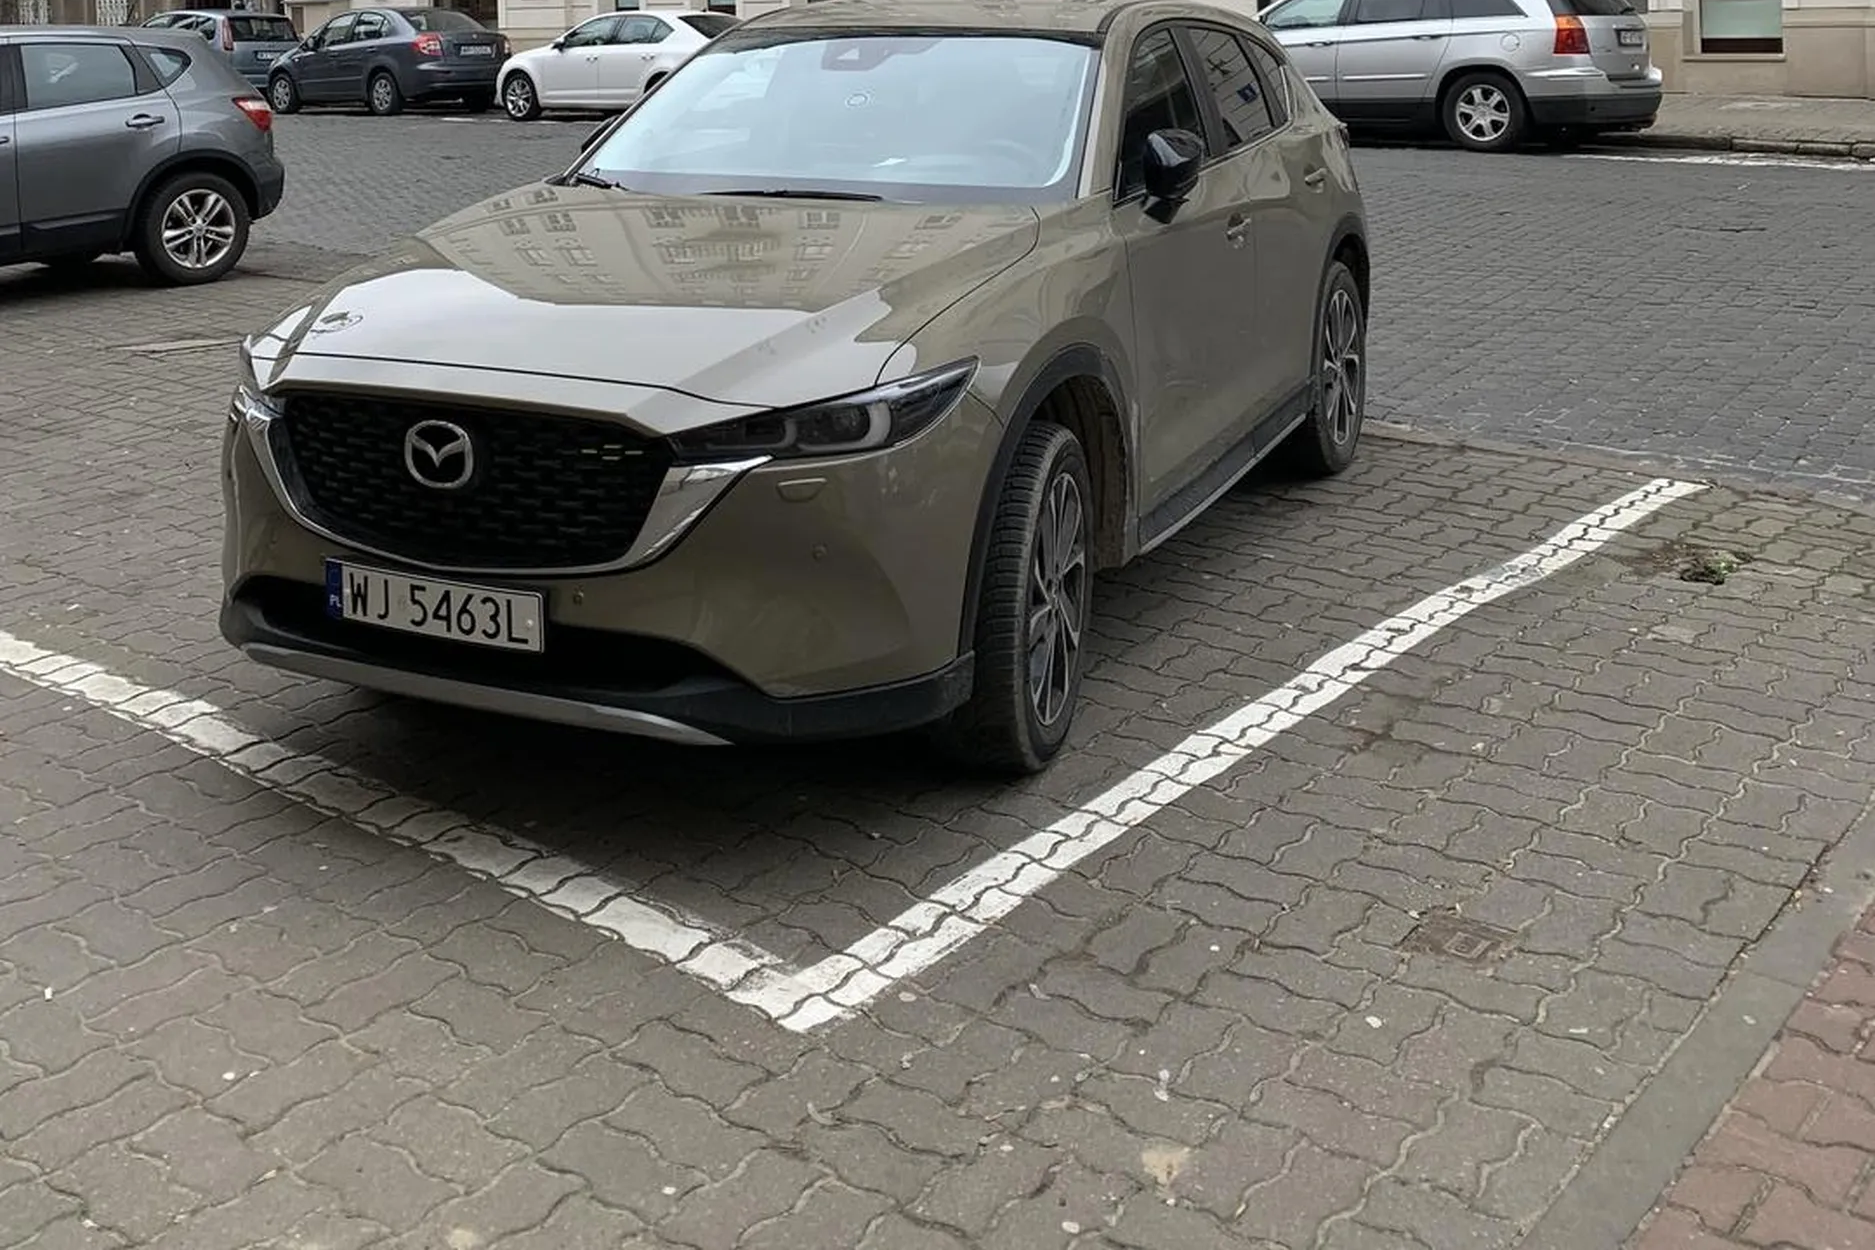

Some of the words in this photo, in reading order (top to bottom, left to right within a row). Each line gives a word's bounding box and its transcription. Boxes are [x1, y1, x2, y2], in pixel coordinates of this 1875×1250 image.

[329, 593, 342, 608] PL
[350, 572, 390, 620] WJ
[410, 583, 529, 645] 5463L
